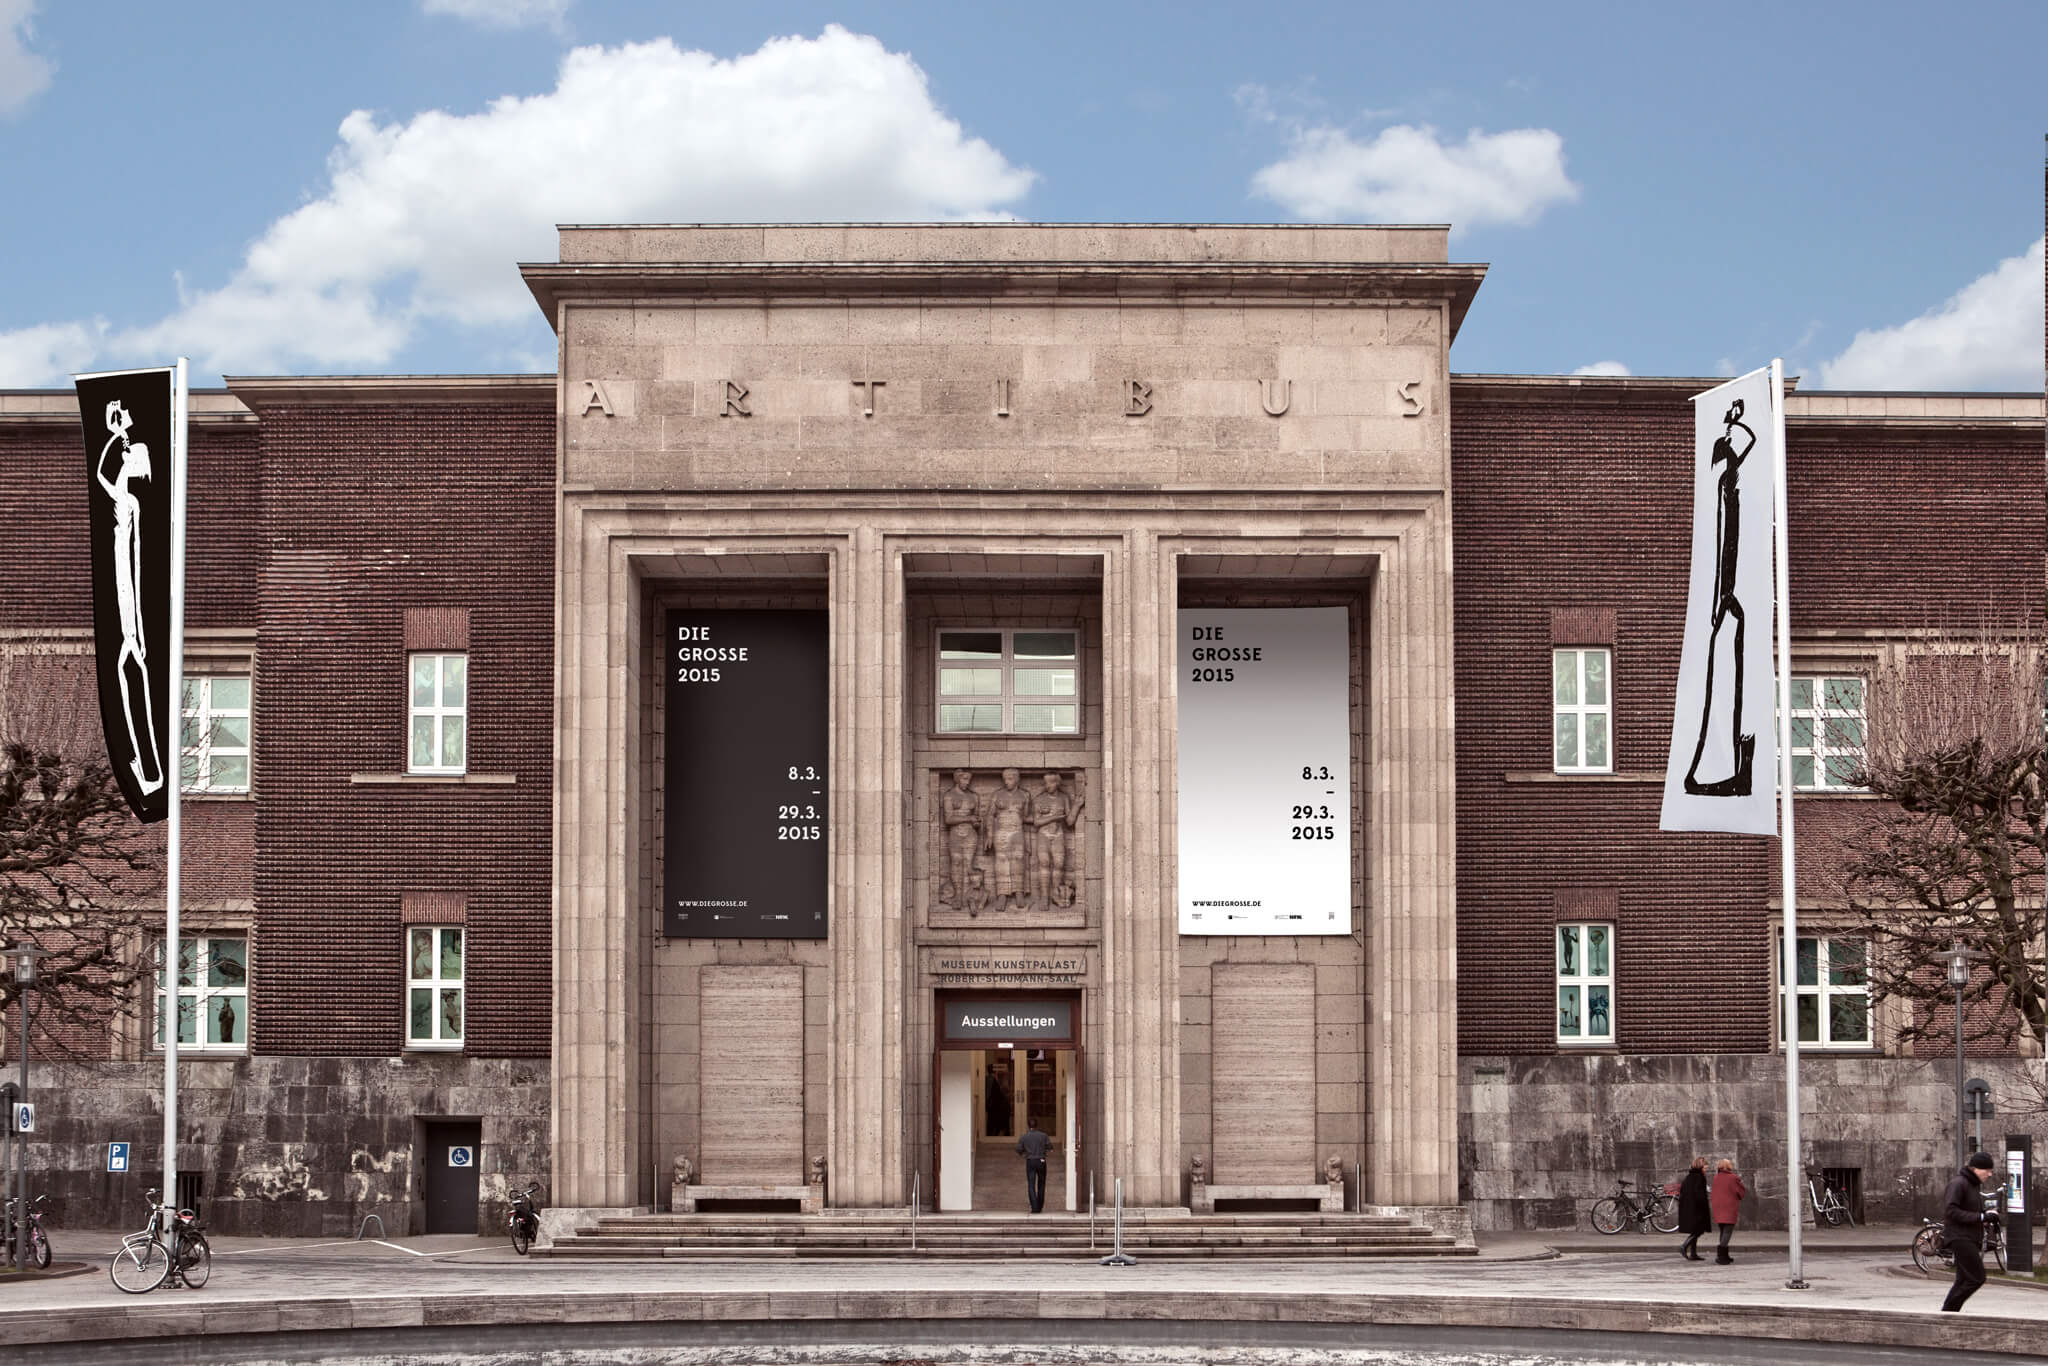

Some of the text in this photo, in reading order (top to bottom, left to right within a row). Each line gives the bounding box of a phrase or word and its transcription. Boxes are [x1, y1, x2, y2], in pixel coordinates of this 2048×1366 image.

[581, 379, 1425, 418] ARTIBUS
[678, 627, 710, 640] DIE
[1192, 627, 1224, 640] DIE
[678, 648, 748, 661] GROSSE
[1192, 648, 1262, 661] GROSSE
[678, 668, 720, 682] 2015
[1192, 668, 1234, 682] 2015
[788, 766, 821, 780] 8.3.
[1302, 766, 1335, 780] 8.3.
[778, 805, 821, 819] 29.3.
[1292, 805, 1335, 819] 29.3.
[778, 826, 821, 840] 2015
[1292, 826, 1335, 840] 2015
[941, 960, 1077, 969] MUSEUM KUNSTPALAST
[940, 975, 1076, 984] ROBERT-SCHUMANN-SAAL
[961, 1015, 1056, 1029] Ausstellungen
[112, 1145, 121, 1157] P
